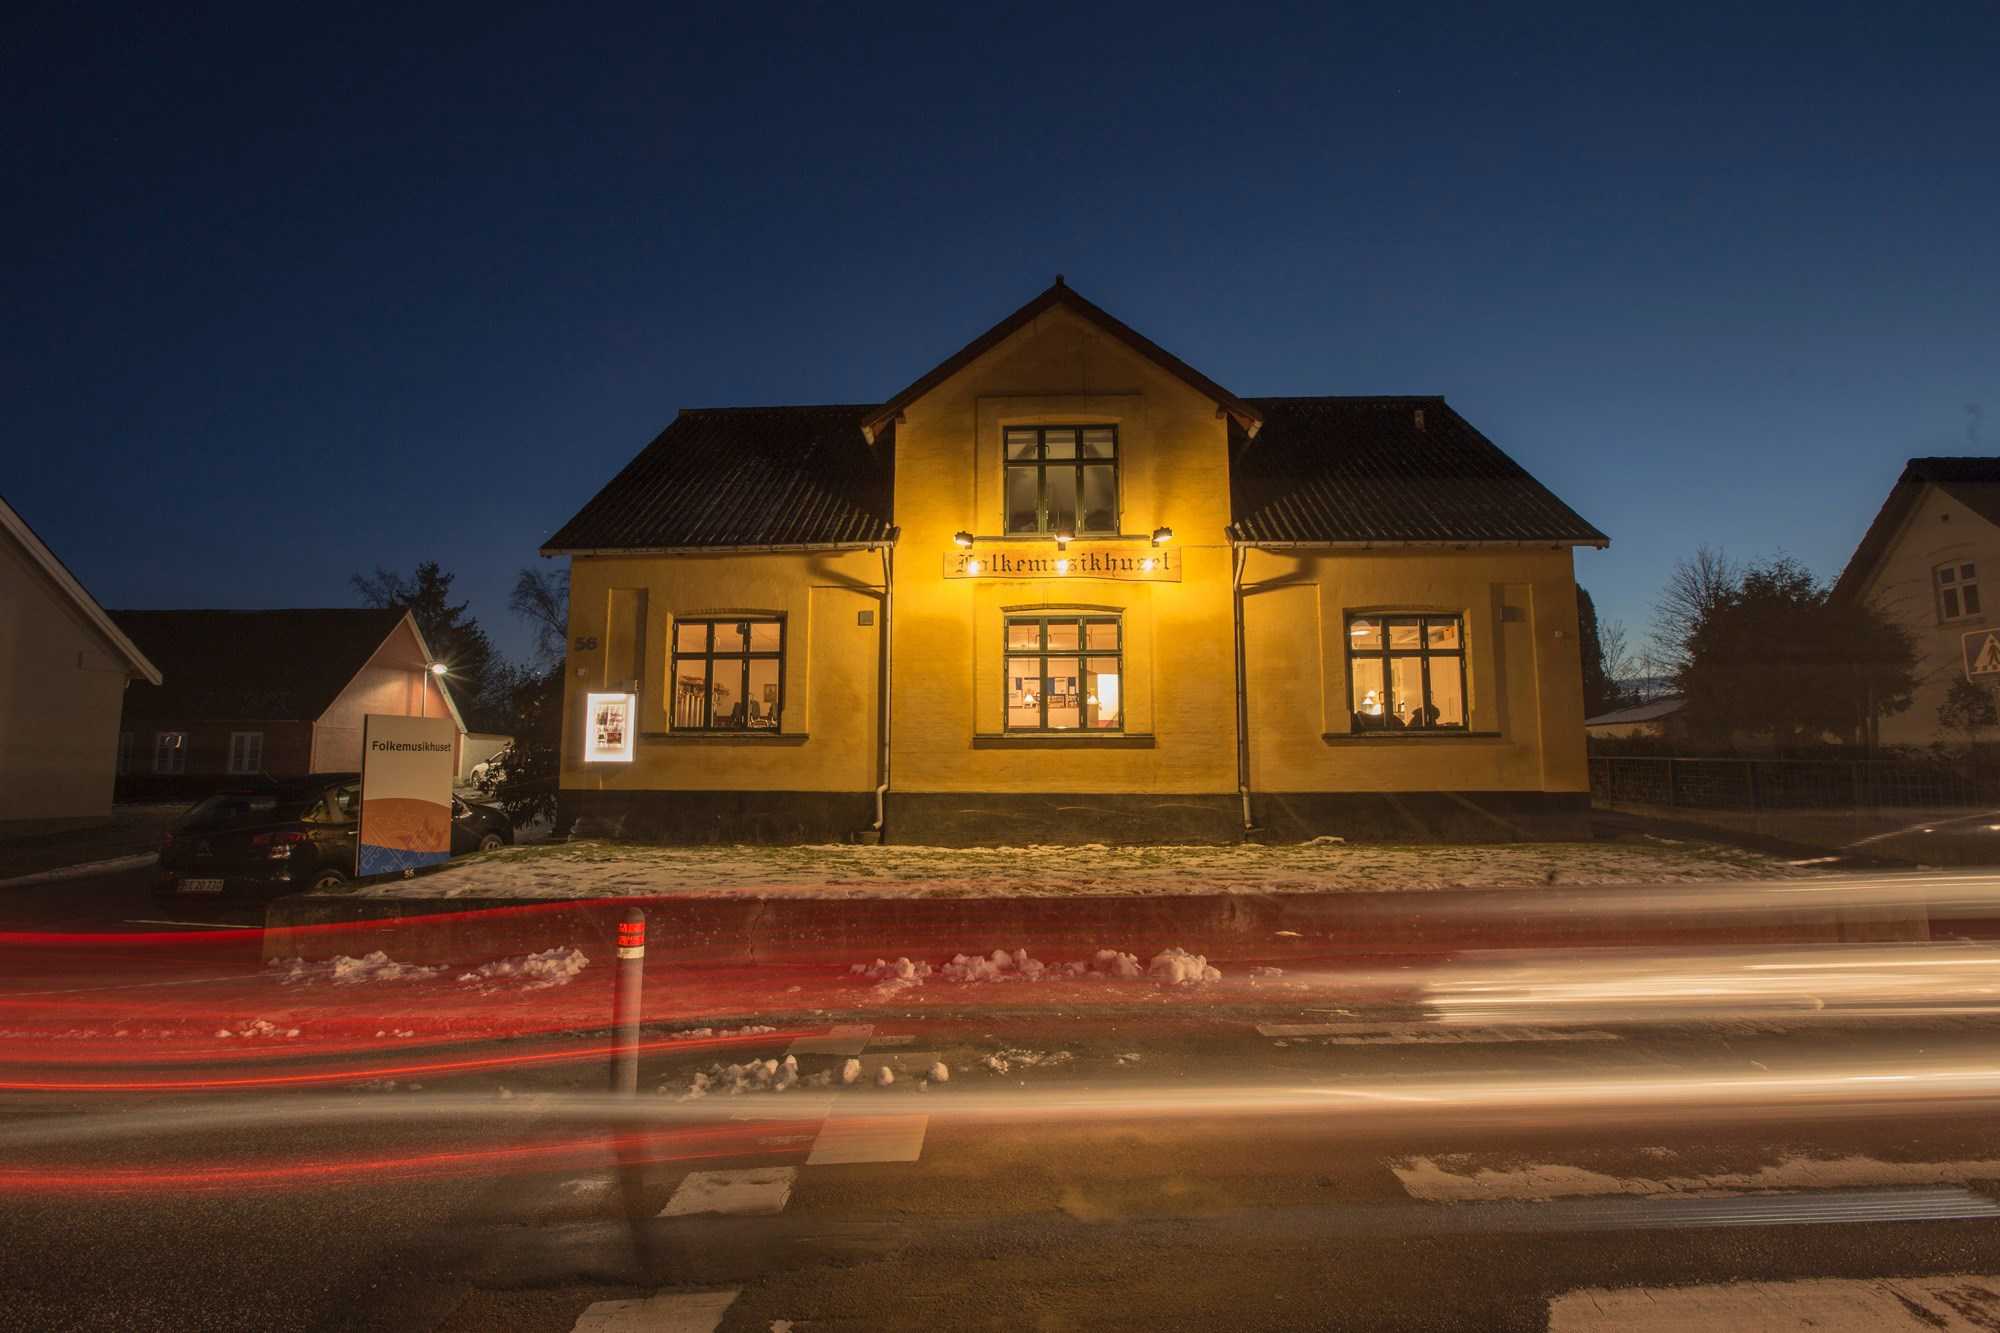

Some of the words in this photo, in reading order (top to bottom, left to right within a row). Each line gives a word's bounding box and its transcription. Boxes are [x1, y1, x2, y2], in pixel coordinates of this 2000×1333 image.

[955, 552, 1170, 577] Folkemsikhuset
[574, 637, 598, 651] 56
[372, 740, 451, 752] Folkemusikhuset
